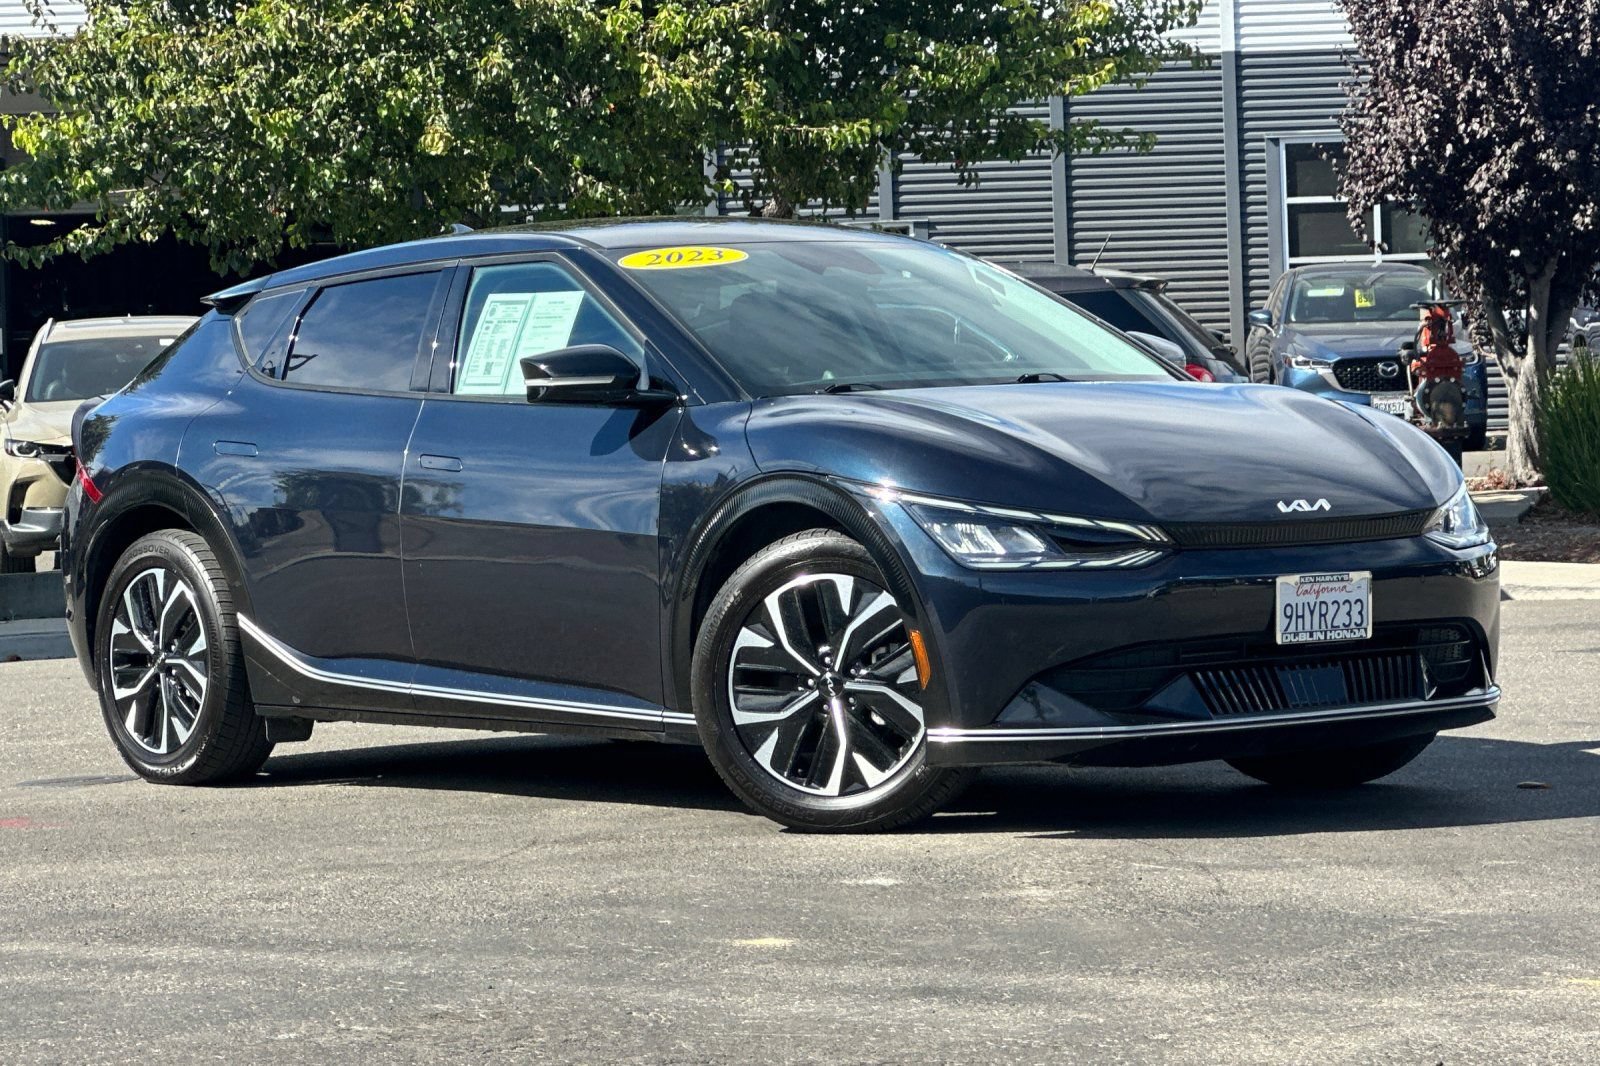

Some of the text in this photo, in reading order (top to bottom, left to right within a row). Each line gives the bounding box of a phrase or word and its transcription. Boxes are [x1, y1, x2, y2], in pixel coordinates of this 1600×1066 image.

[645, 250, 724, 266] 2023
[1276, 498, 1332, 513] KIA
[122, 544, 171, 564] CROSSOVER
[1301, 574, 1349, 583] KEN HARVEY'S
[1296, 584, 1353, 599] California
[1283, 598, 1364, 632] 9HYR233
[1282, 628, 1367, 642] DUBLIN HONDA
